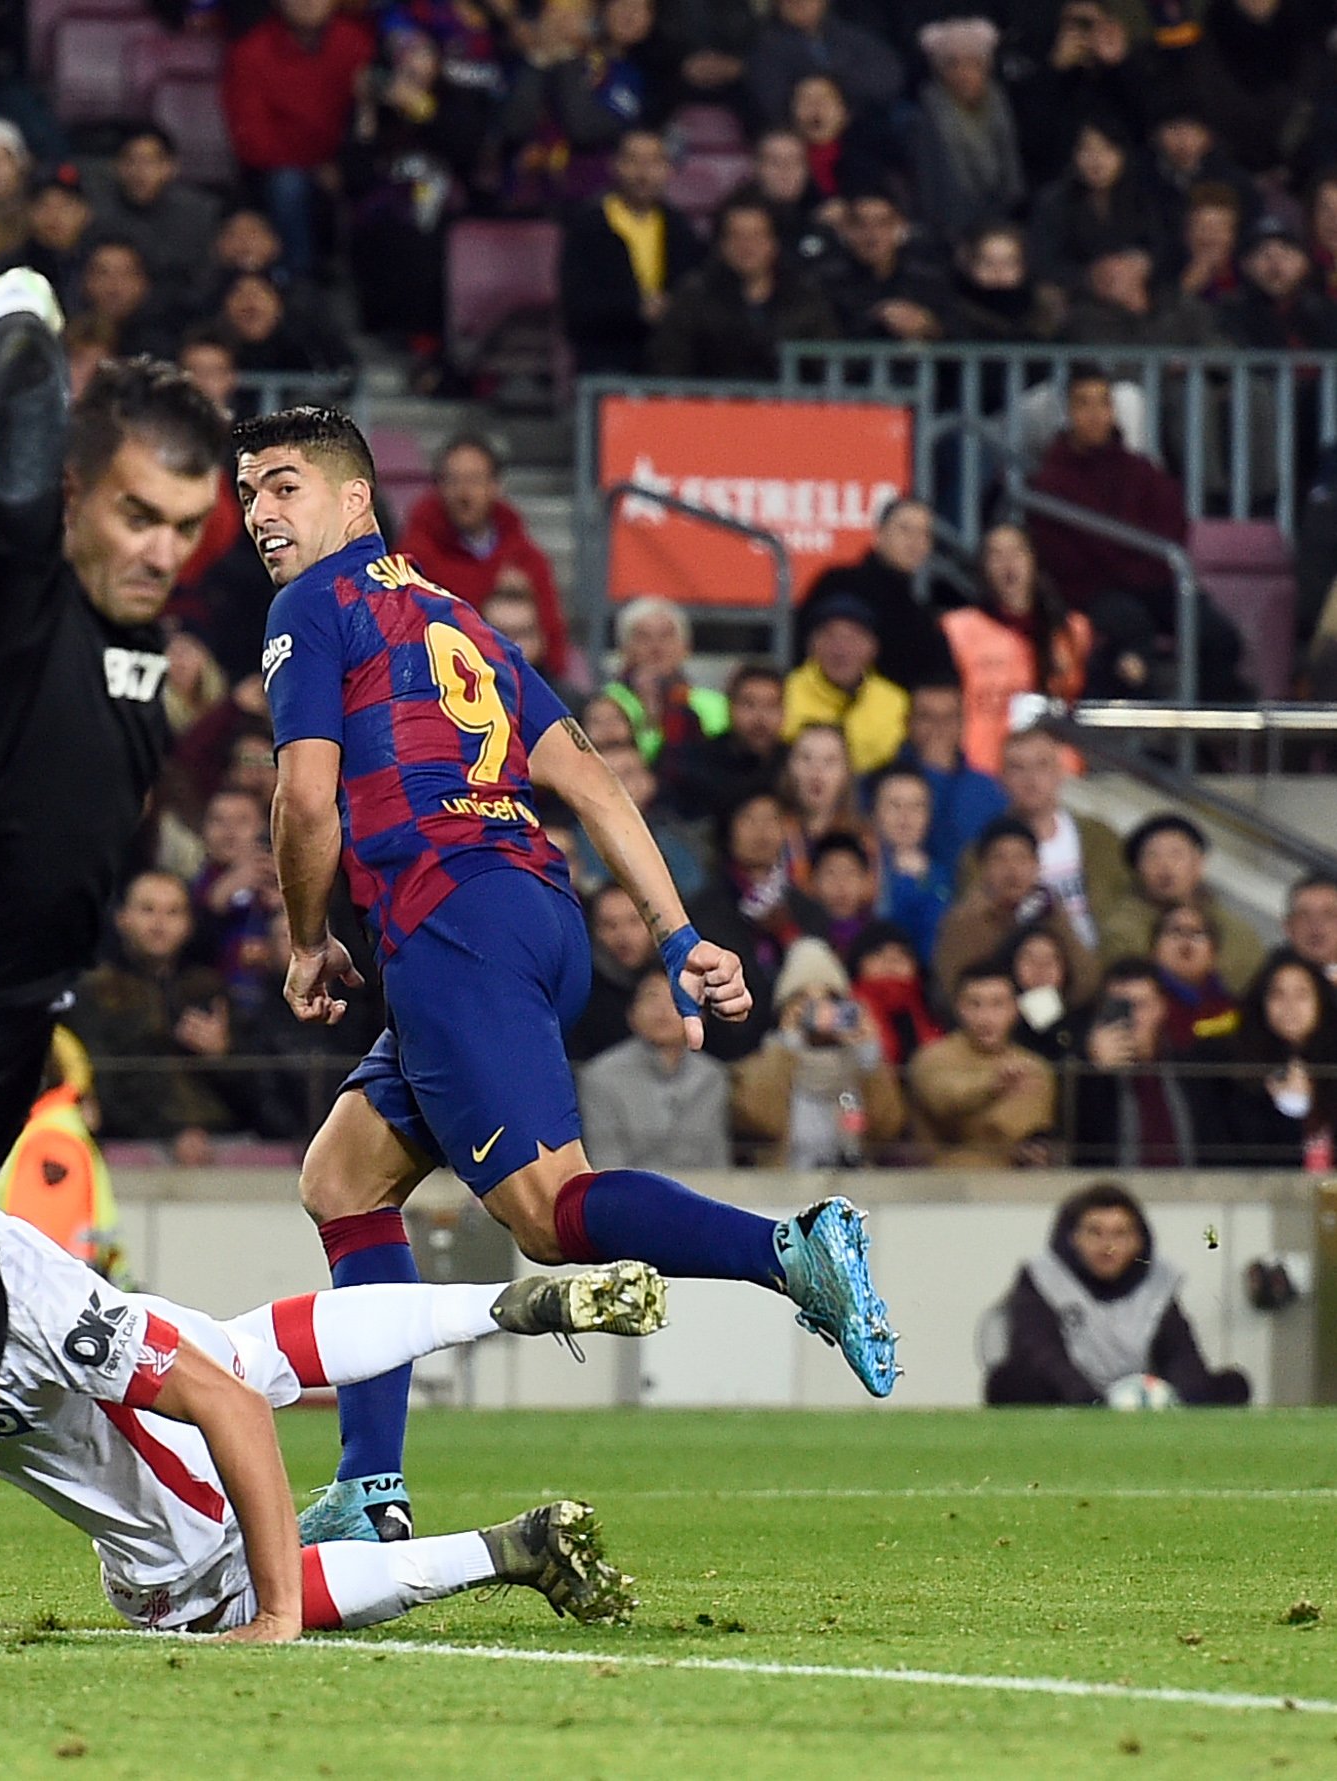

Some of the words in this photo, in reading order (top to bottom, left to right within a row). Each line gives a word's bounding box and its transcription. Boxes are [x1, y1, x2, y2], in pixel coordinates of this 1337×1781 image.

[262, 633, 293, 671] eko
[424, 621, 511, 786] 9
[441, 793, 518, 821] unicef
[64, 1288, 129, 1367] OK
[122, 1314, 139, 1337] CAR
